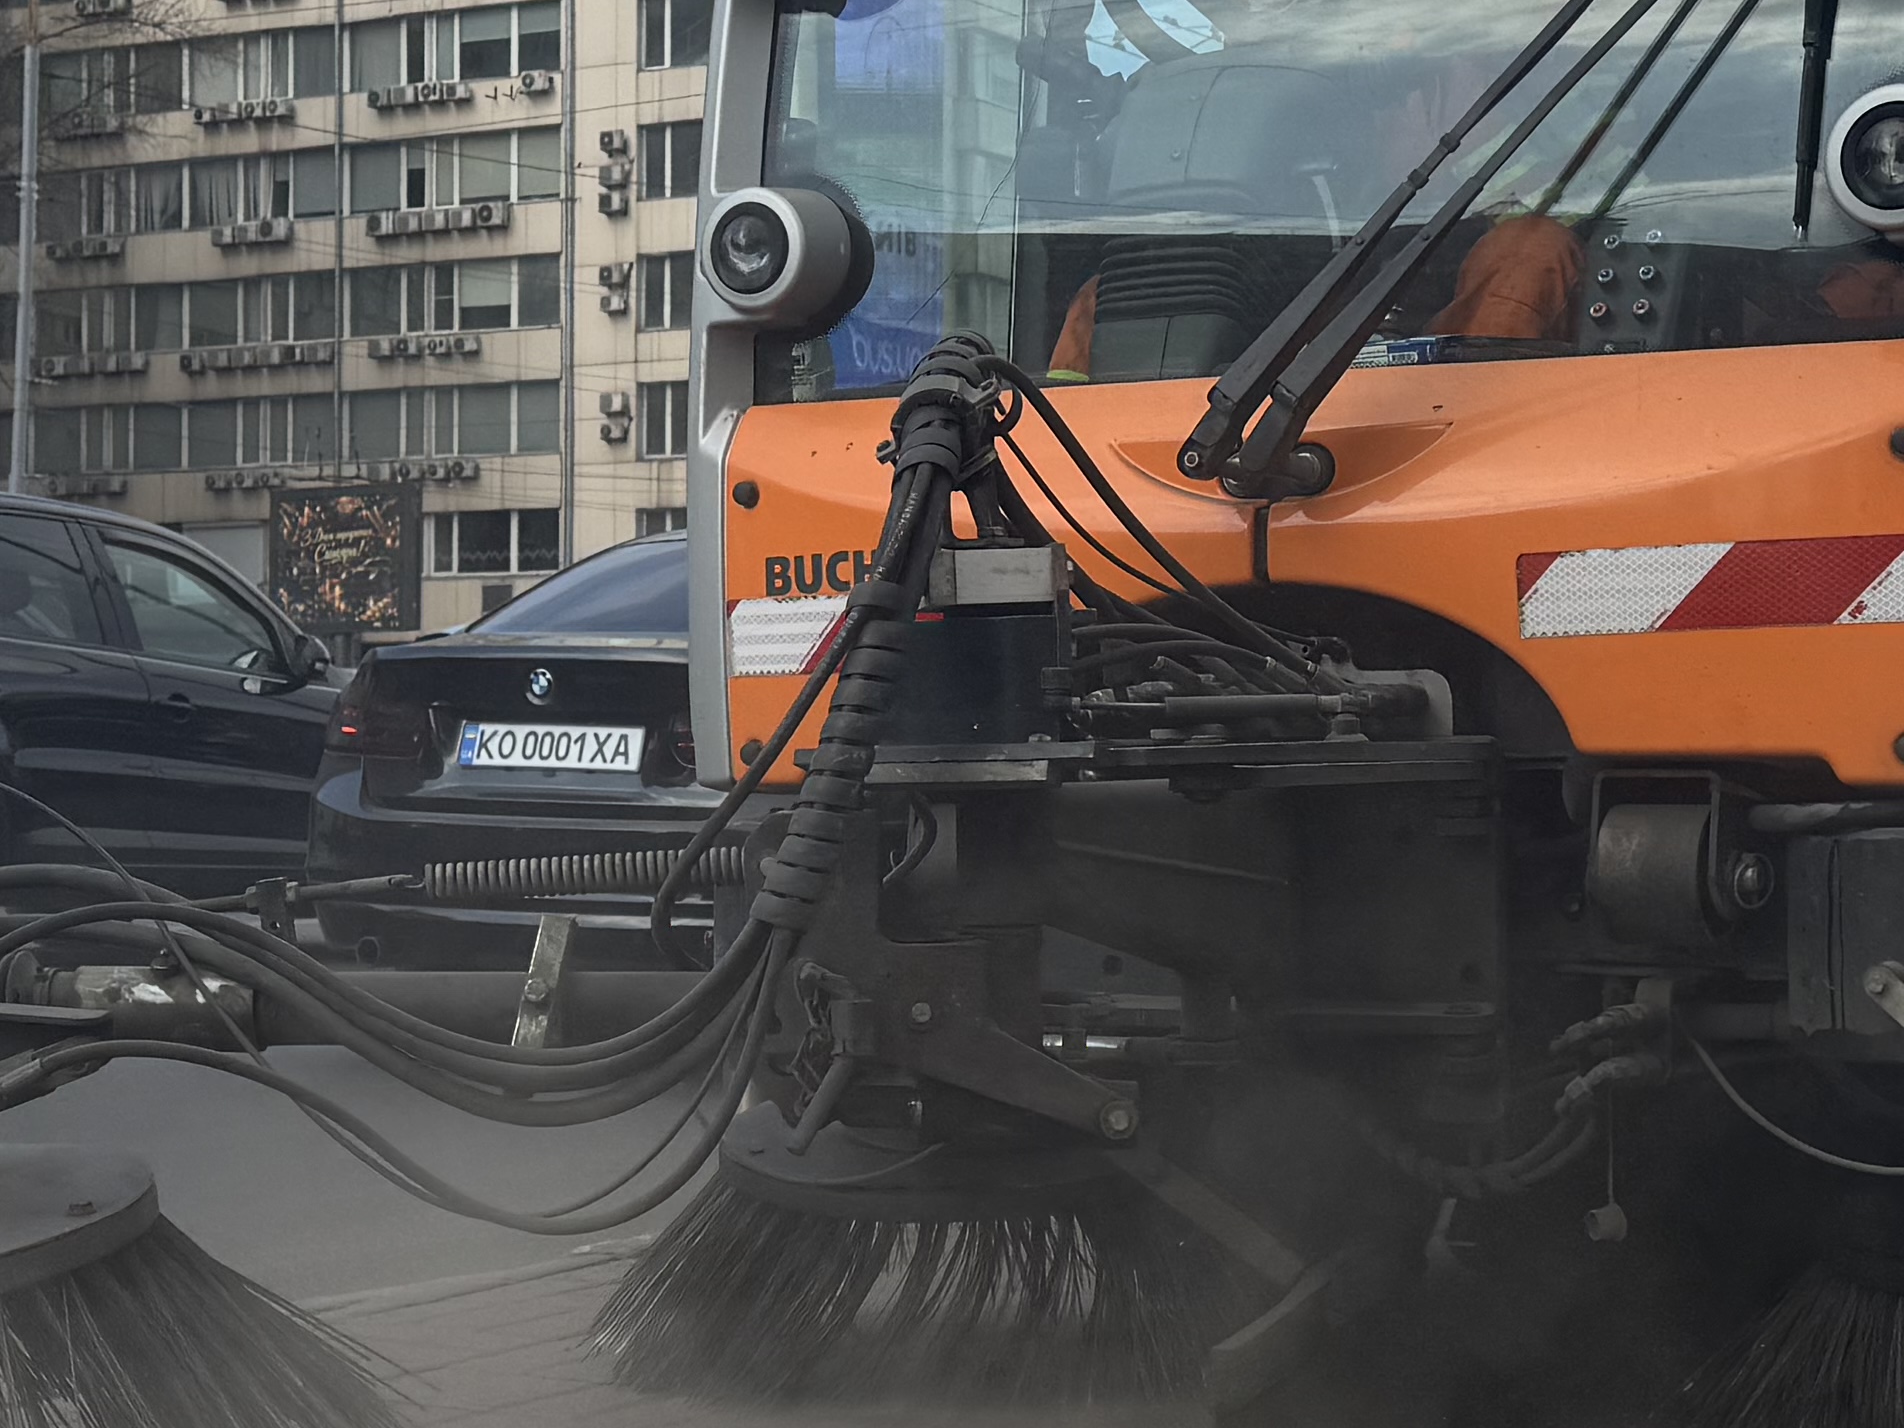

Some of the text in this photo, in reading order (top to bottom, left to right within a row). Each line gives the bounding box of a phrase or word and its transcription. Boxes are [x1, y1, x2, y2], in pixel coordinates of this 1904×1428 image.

[764, 549, 879, 597] BUCH
[475, 729, 630, 765] KO 0001 XA
